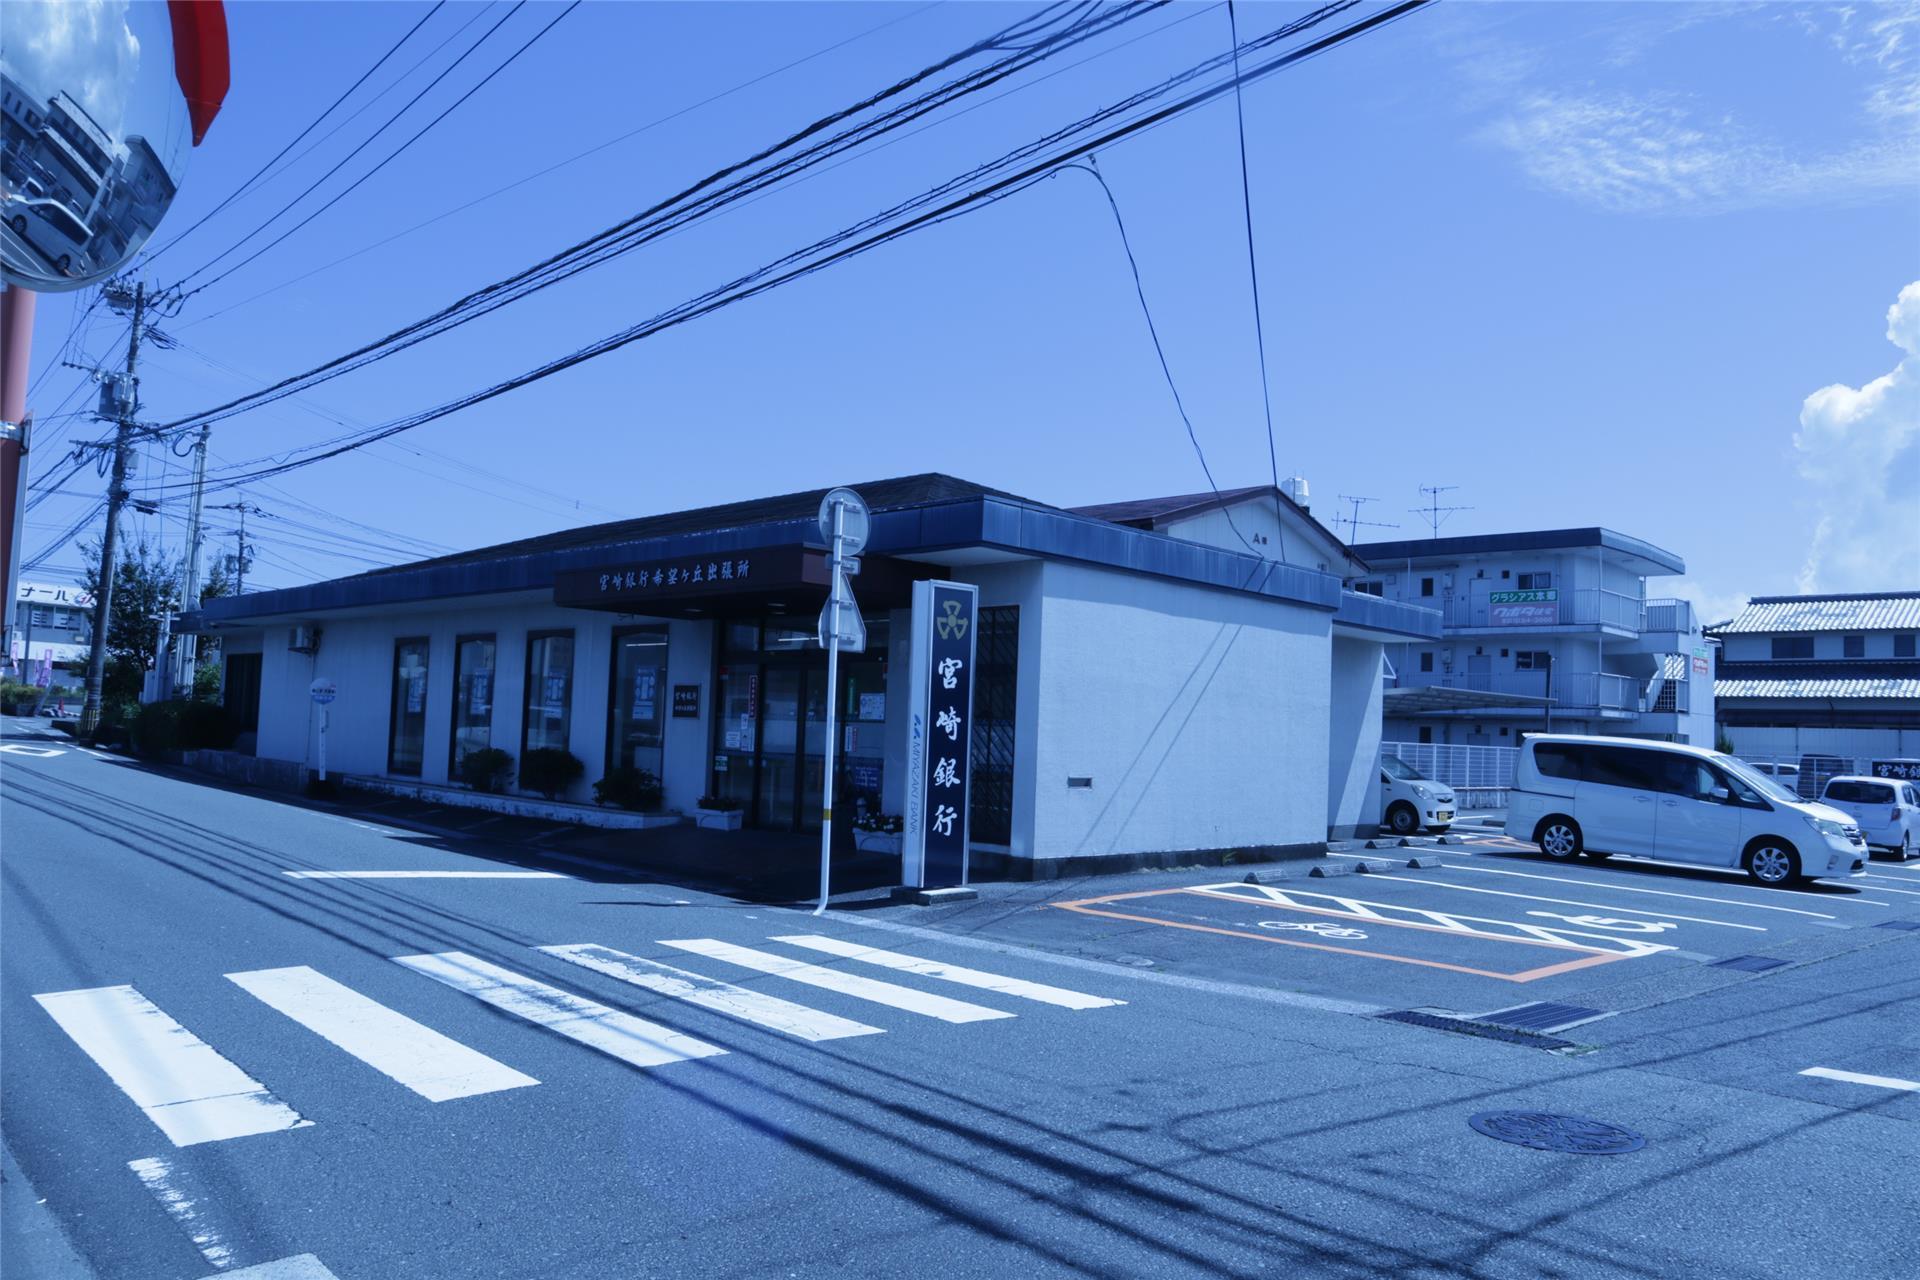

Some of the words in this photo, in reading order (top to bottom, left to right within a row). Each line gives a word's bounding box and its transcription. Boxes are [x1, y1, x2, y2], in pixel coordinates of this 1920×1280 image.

[1252, 533, 1268, 545] A
[933, 657, 963, 837] 宮崎銀行
[910, 741, 921, 799] MIYAZAKI
[909, 801, 919, 834] BANK
